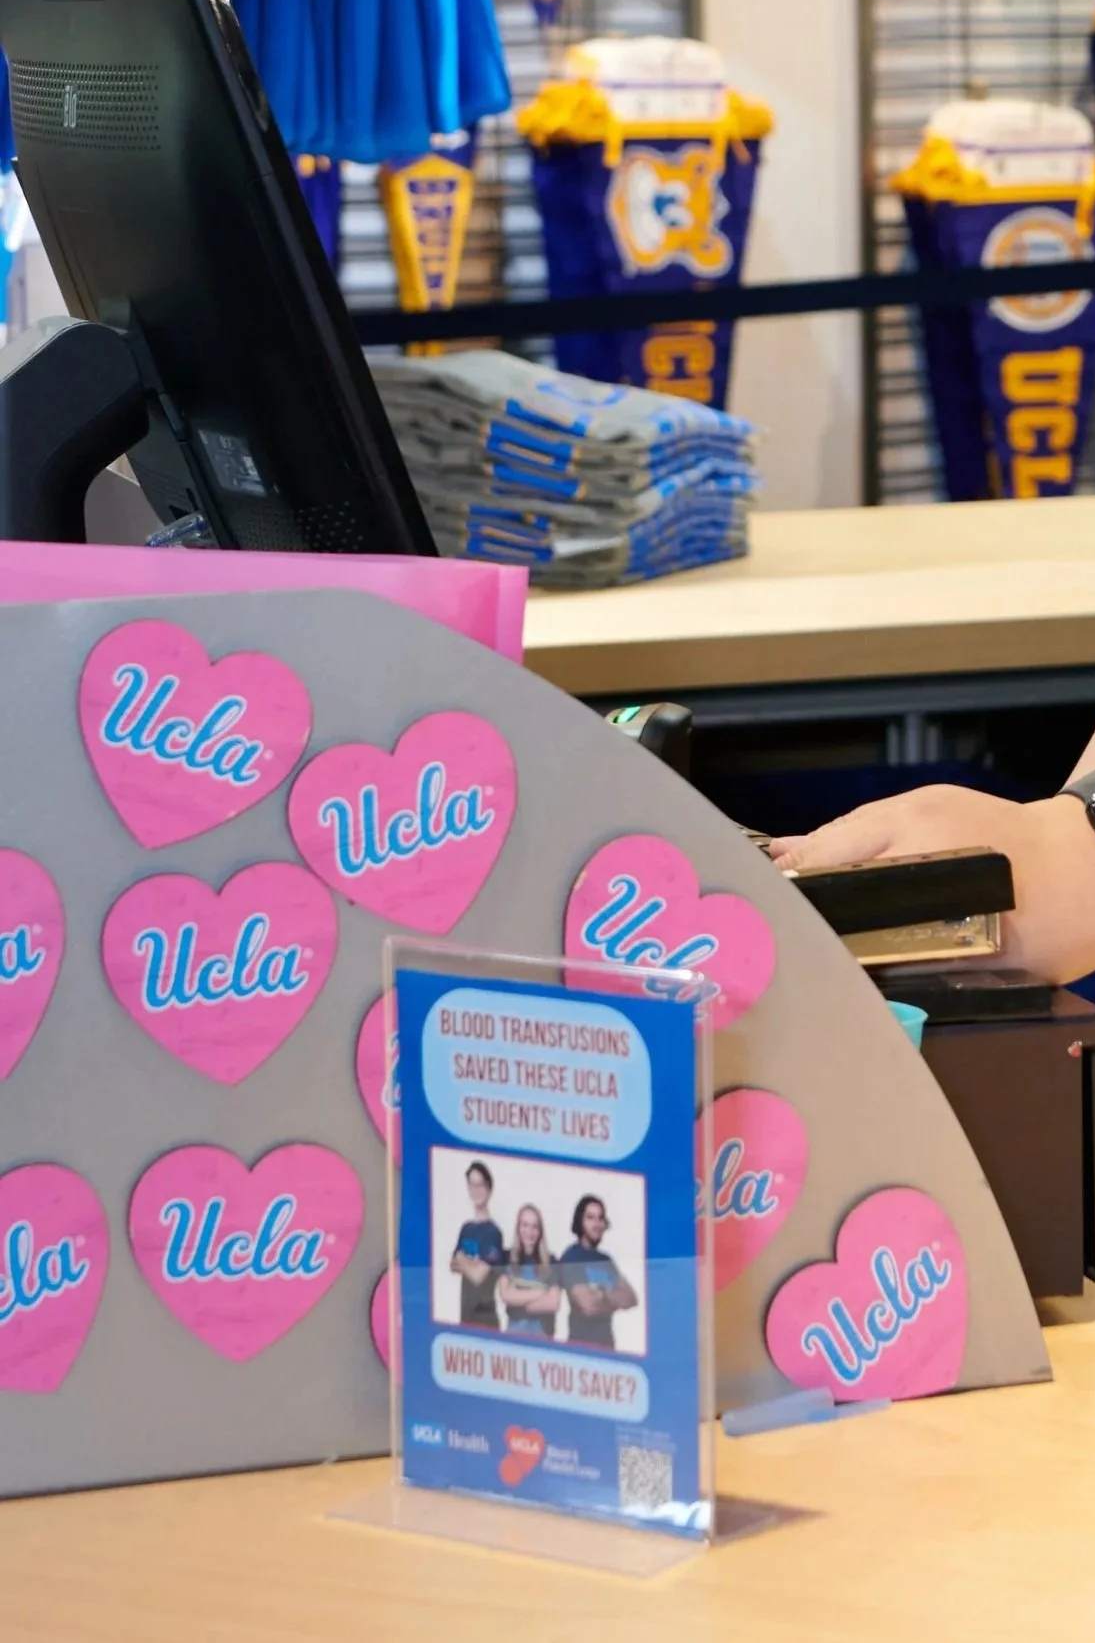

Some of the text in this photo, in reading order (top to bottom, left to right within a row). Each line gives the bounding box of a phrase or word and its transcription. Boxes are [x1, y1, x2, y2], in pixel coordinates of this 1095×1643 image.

[99, 664, 264, 788] Ucla
[319, 761, 495, 877] Ucla
[134, 913, 310, 1013] Ucla
[440, 1008, 630, 1058] BLOOD TRANSFUSIONS
[453, 1053, 618, 1099] SAVED THESE UCLA
[462, 1096, 611, 1142] STUDENTS' LIVES
[160, 1194, 329, 1283] Ucla
[801, 1239, 952, 1387] Ucla
[442, 1345, 638, 1403] WHO WILL YOU SAVE?
[411, 1423, 490, 1454] UCLA Health
[509, 1436, 541, 1455] UCLA
